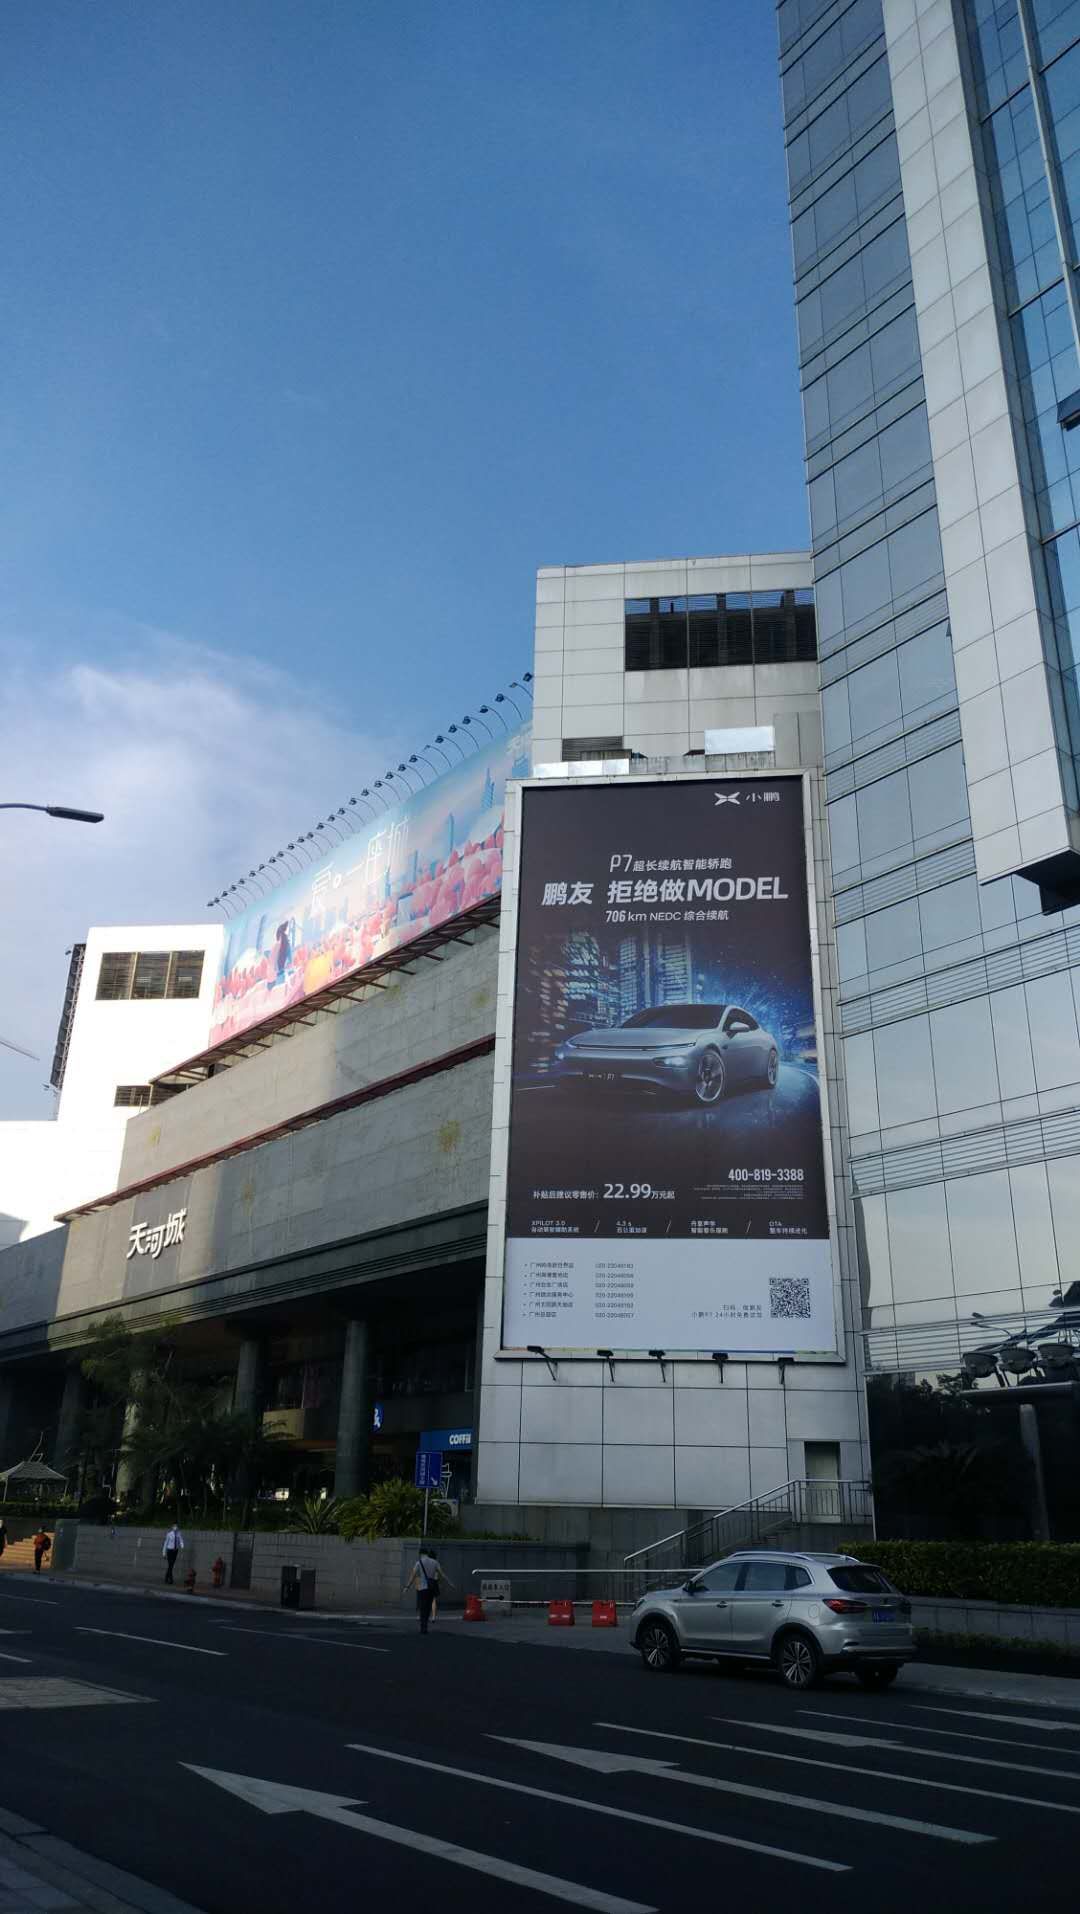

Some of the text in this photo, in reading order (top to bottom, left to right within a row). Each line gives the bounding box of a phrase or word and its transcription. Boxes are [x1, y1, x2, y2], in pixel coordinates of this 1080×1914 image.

[745, 791, 780, 802] 小鹏
[541, 876, 789, 906] 鹏友 拒绝做MODEL
[605, 909, 729, 923] 706 km NEDC 综合续航
[728, 1168, 805, 1181] 400-819-3388
[126, 1207, 188, 1259] 天河城
